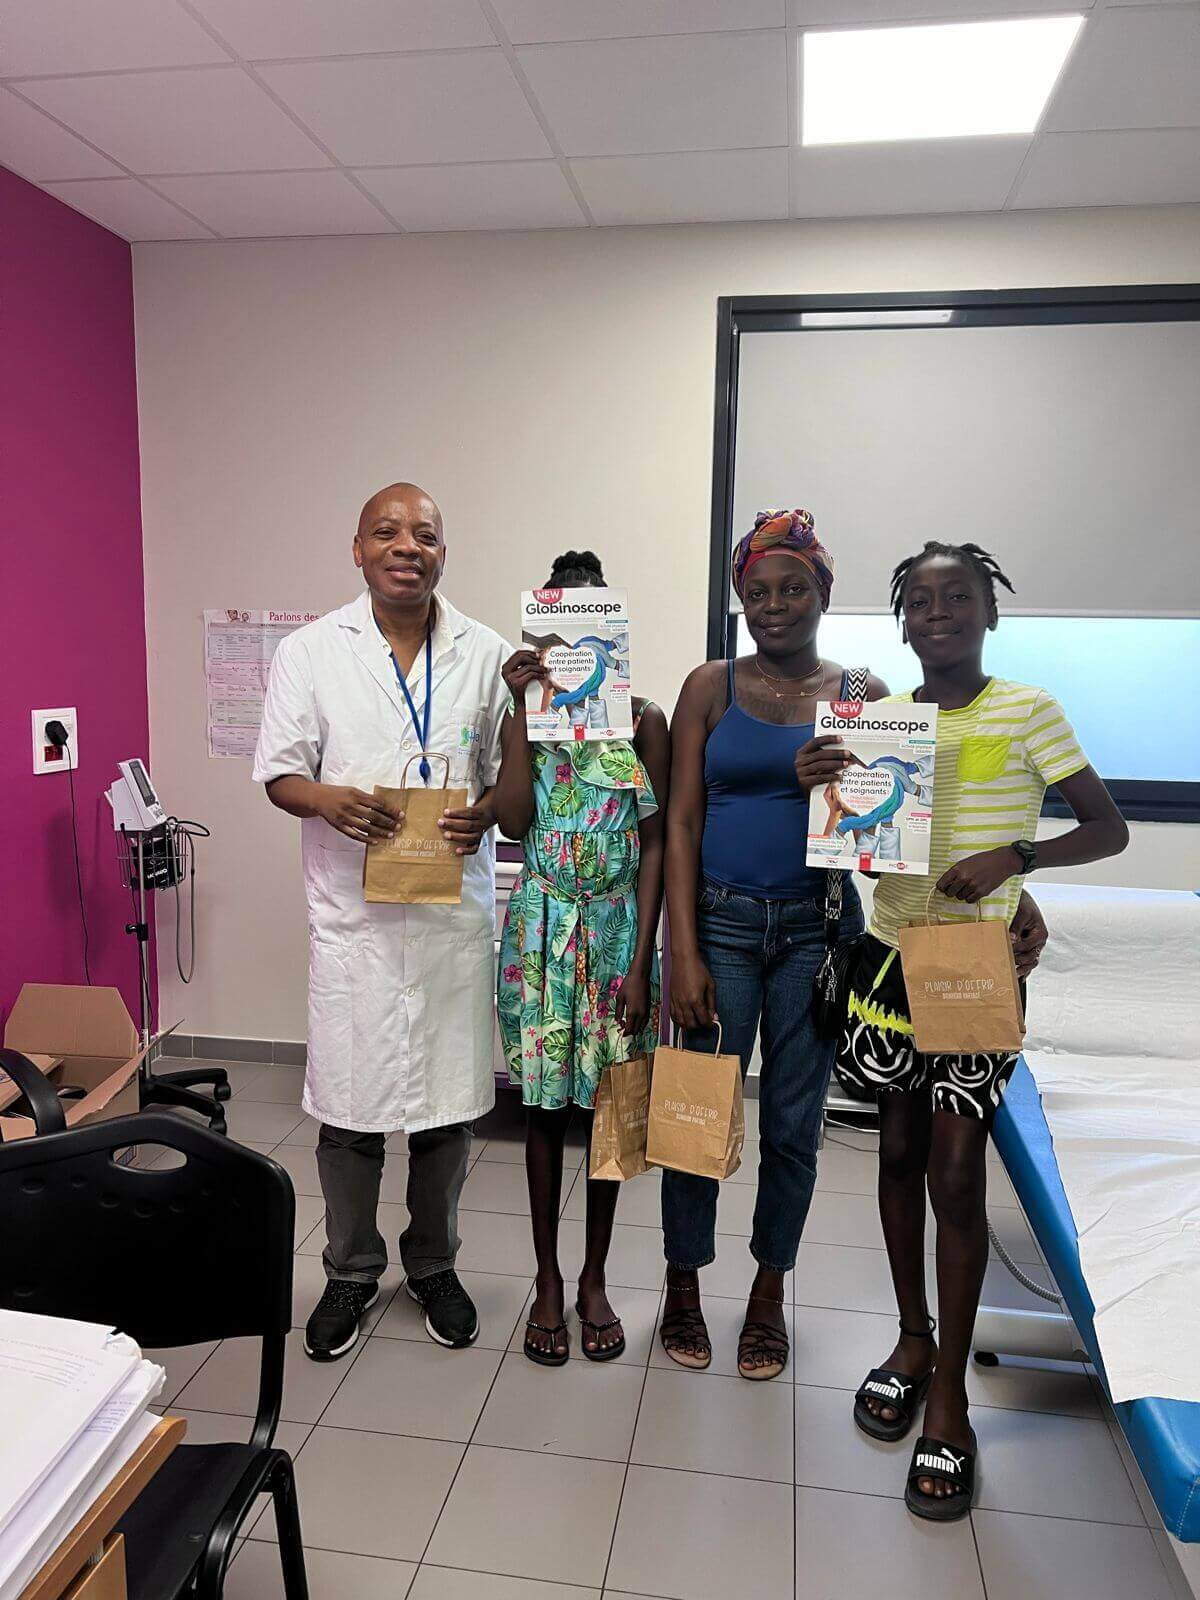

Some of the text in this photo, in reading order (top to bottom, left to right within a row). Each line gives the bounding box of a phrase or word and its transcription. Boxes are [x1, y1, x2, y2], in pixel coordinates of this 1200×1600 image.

[537, 590, 560, 600] NEW
[525, 602, 622, 615] Globinoscope
[269, 612, 301, 621] Parlons
[550, 651, 593, 659] Coopération
[567, 659, 595, 667] patients
[834, 703, 860, 713] NEW
[820, 716, 930, 734] Globinoscope
[841, 770, 890, 779] Coopération
[860, 778, 892, 787] patients
[924, 981, 952, 993] PLAISIR
[864, 1381, 899, 1399] PUMA
[916, 1453, 955, 1473] PUMA
